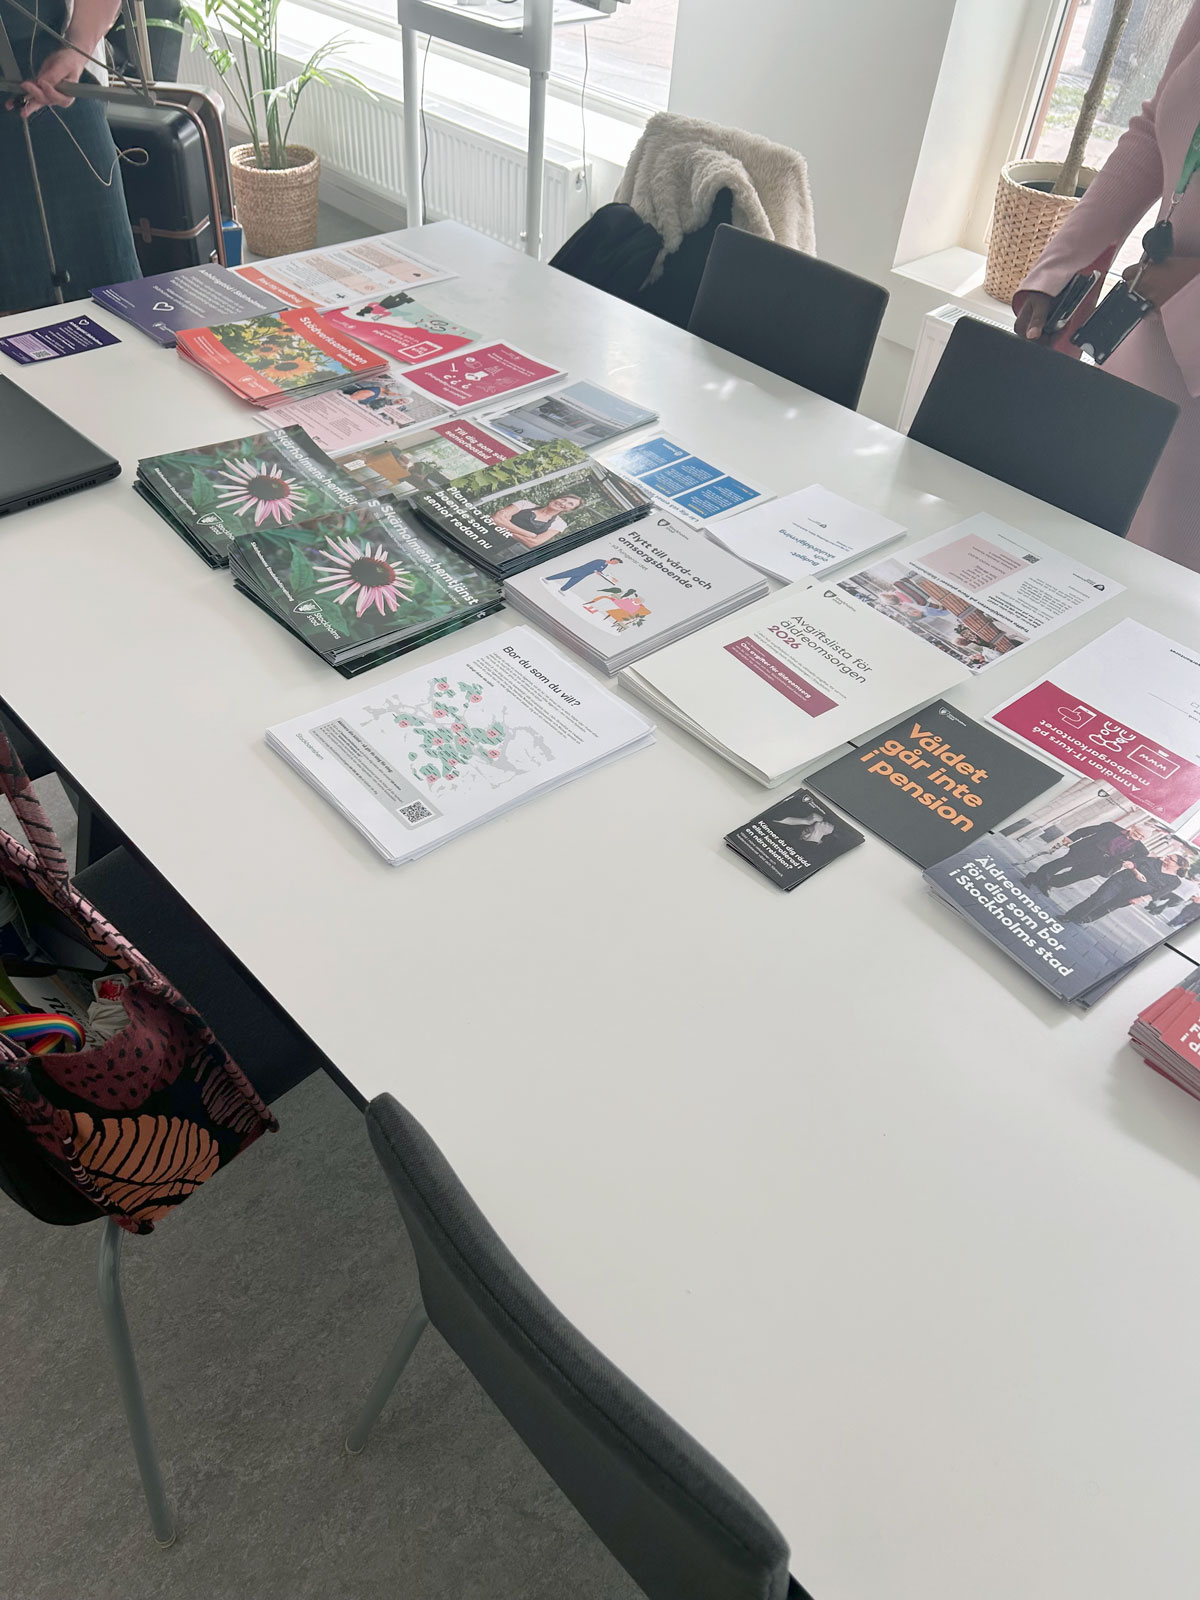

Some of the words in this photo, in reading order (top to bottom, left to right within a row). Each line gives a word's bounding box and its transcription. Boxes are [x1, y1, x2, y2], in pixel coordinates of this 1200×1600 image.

[299, 316, 368, 365] Stödverksamheten
[273, 429, 326, 481] Skärholmens
[445, 430, 492, 460] seniorbostad
[454, 426, 468, 436] Till
[465, 435, 478, 444] dig
[477, 443, 494, 453] som
[423, 495, 453, 518] senior
[450, 518, 479, 540] redan
[476, 539, 493, 550] nu
[435, 490, 470, 519] boende
[467, 518, 489, 535] som
[446, 486, 482, 516] Planera
[480, 514, 497, 526] för
[494, 526, 514, 538] ditt
[381, 505, 434, 564] Skärholmens
[430, 562, 479, 606] hemtjänst
[618, 536, 693, 589] omsorgsboende
[627, 531, 652, 549] Flytt
[651, 547, 668, 559] till
[666, 557, 692, 576] vård-
[692, 576, 712, 590] och
[779, 528, 836, 559] skuldrådgivning
[790, 551, 820, 567] Budget-
[306, 614, 321, 627] stad
[314, 612, 341, 640] Stockholms
[768, 625, 802, 649] 2026
[791, 616, 853, 660] Avgiftslista
[852, 658, 873, 672] för
[740, 642, 751, 652] Om
[749, 650, 771, 667] avgifter
[769, 664, 779, 674] för
[780, 619, 867, 684] äldreomsorgen
[502, 645, 521, 660] Bor
[518, 659, 532, 669] du
[530, 668, 550, 684] som
[548, 684, 562, 694] du
[560, 692, 581, 707] vill?
[860, 749, 880, 762] i
[909, 722, 989, 784] Våldet
[1032, 726, 1050, 737] på
[1040, 719, 1151, 786] medborgarkontoret
[1048, 736, 1088, 762] IT-kurs
[879, 739, 932, 770] går
[927, 767, 983, 808] inte
[1088, 759, 1141, 792] Anmälan
[1138, 753, 1167, 771] www
[867, 760, 974, 833] pension
[745, 828, 754, 836] en
[752, 834, 768, 848] nära
[765, 846, 794, 870] relation?
[751, 824, 766, 837] eller
[764, 835, 800, 867] kontrollerad
[758, 820, 779, 840] Känner
[777, 838, 787, 847] du
[785, 845, 797, 856] dig
[794, 854, 812, 868] rädd
[962, 861, 987, 881] för
[983, 881, 1009, 904] dig
[1006, 902, 1038, 930] som
[1036, 927, 1067, 952] bor
[974, 854, 1065, 934] Äldreomsorg
[949, 868, 961, 877] i
[955, 874, 1037, 948] Stockholms
[1034, 946, 1074, 977] stad
